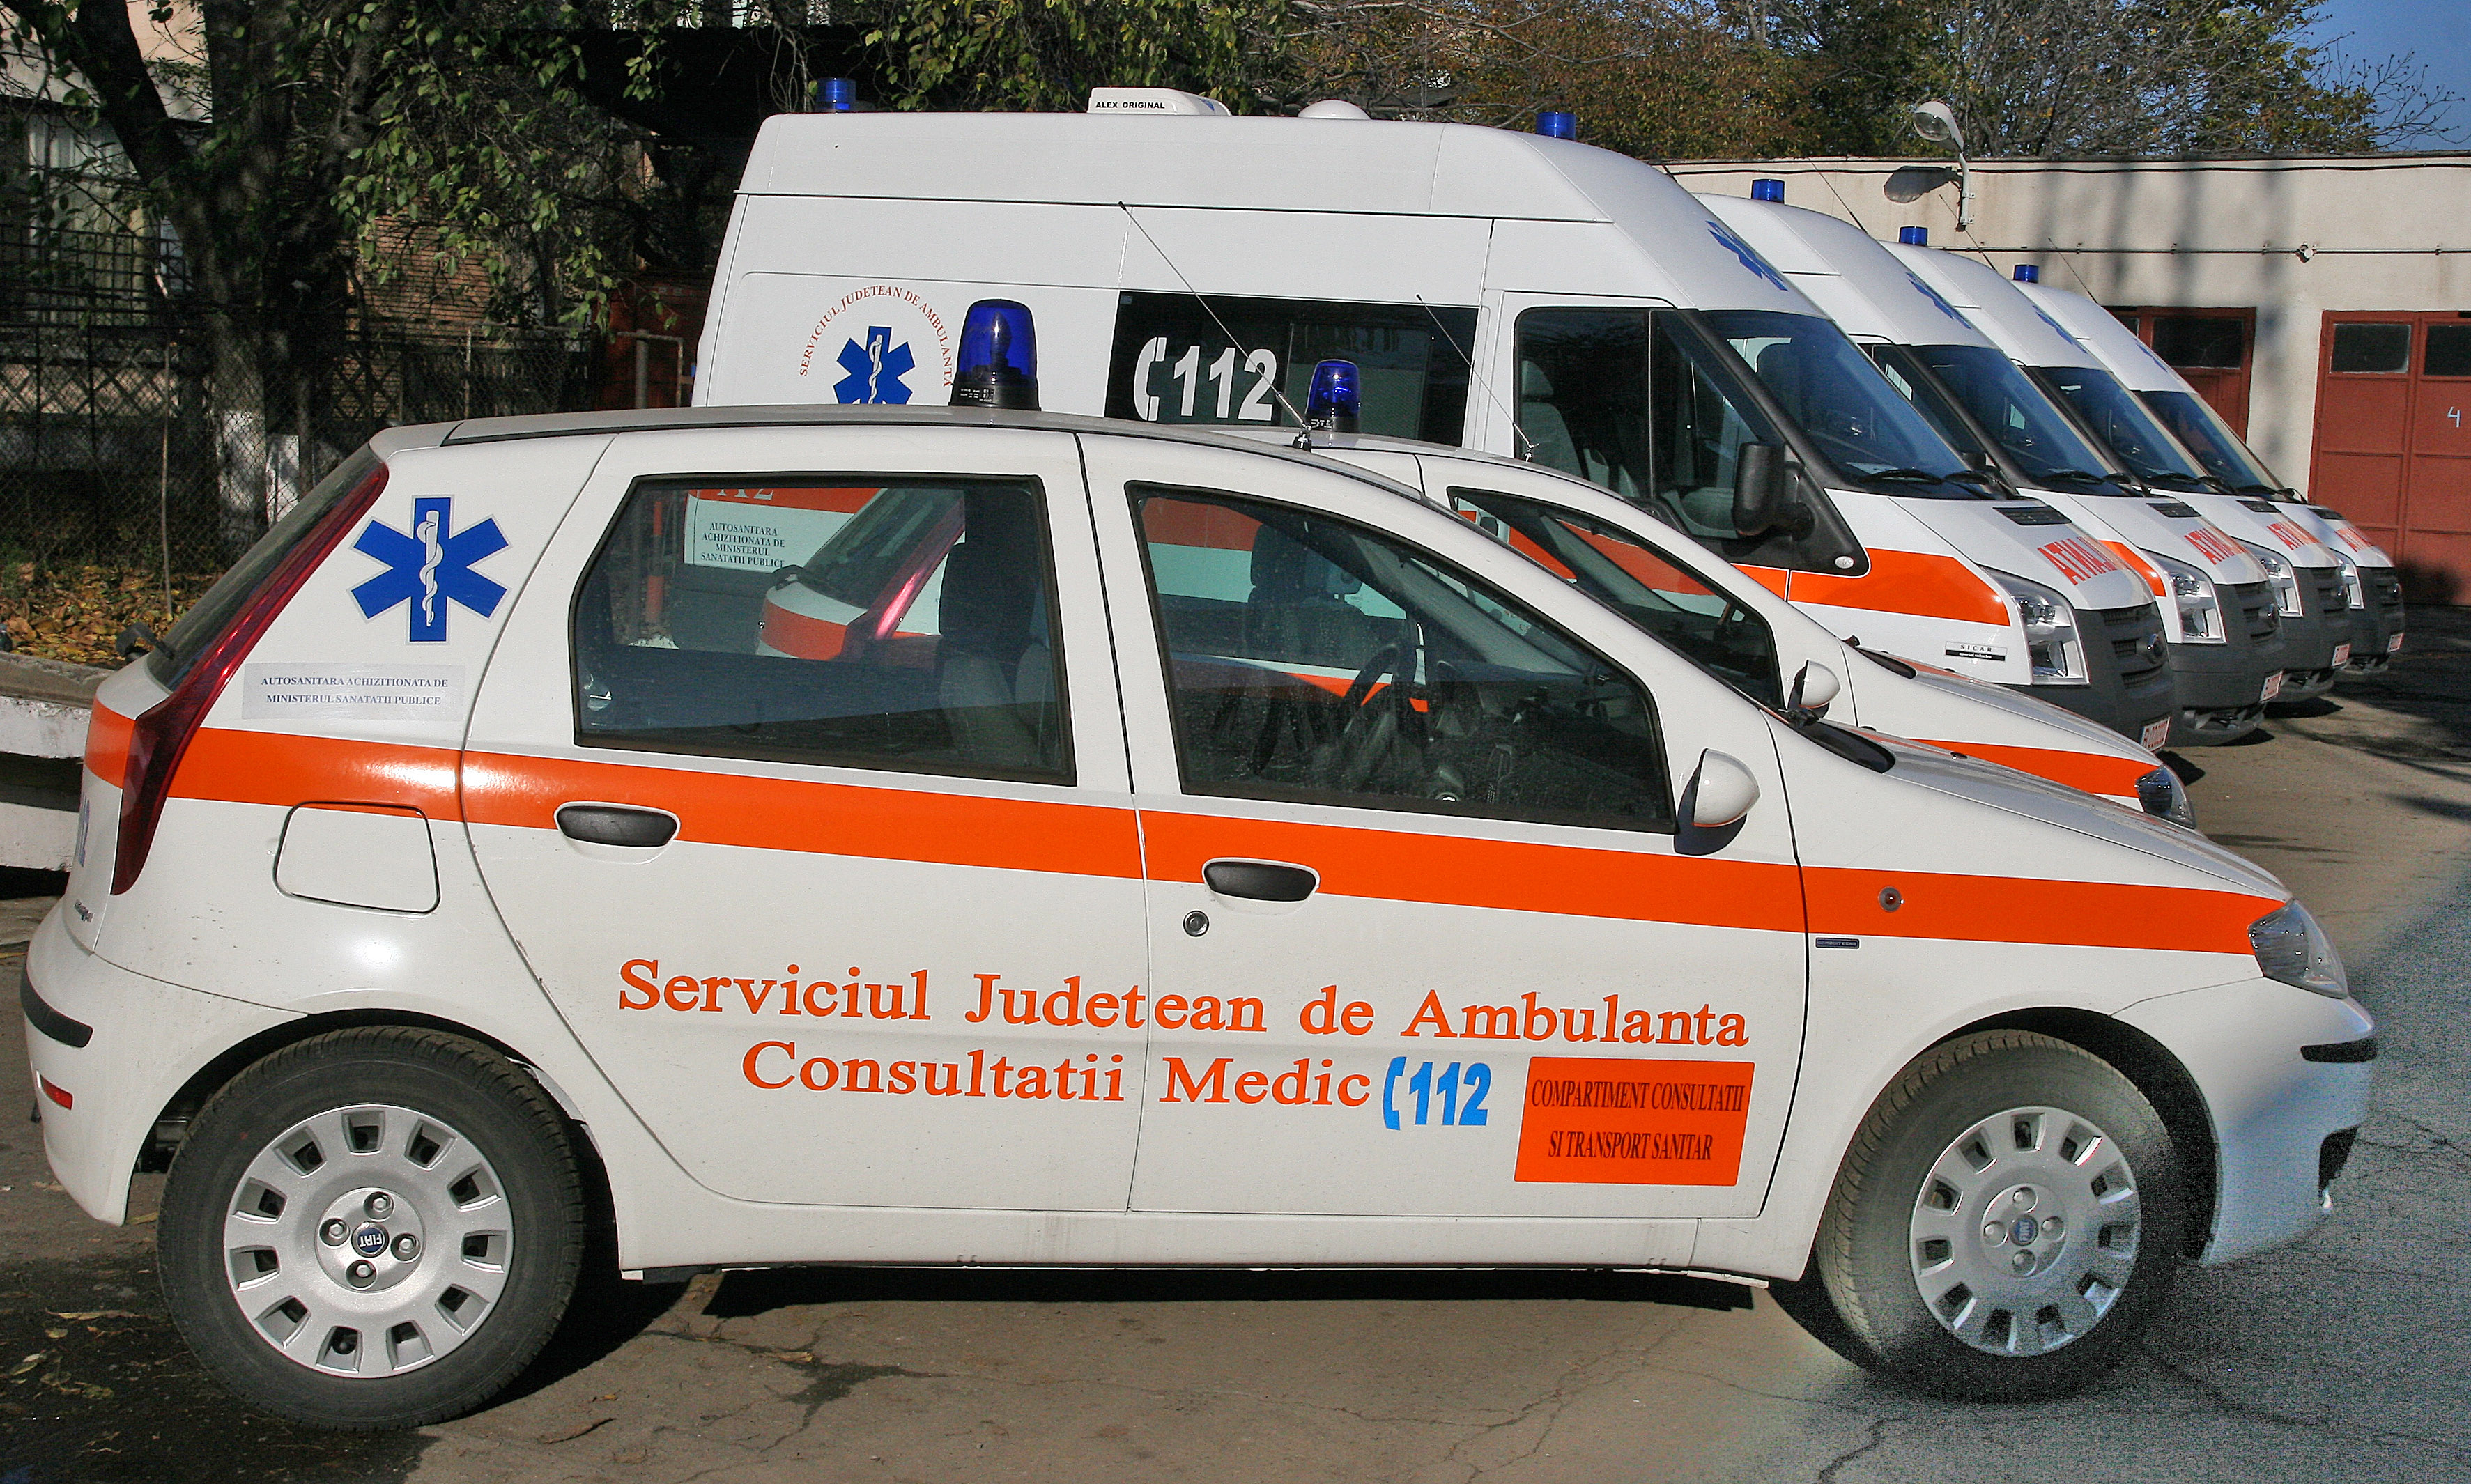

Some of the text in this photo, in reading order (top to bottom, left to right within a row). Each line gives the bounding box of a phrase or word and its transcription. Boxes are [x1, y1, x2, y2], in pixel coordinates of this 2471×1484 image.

[1122, 101, 1165, 109] ORIGINAL
[799, 285, 953, 387] SERVICIUL JUDETEAN DE AMBULANTA
[1173, 346, 1277, 421] 112
[2447, 406, 2461, 428] 4
[709, 522, 778, 536] AUTOSANITARA
[702, 532, 785, 548] ACHIZITIONATA DE
[716, 543, 770, 556] MINISTERUL
[701, 552, 745, 564] SANATATII
[261, 677, 344, 686] AUTOSANITARA
[348, 678, 431, 687] ACHIZITIONATA
[266, 695, 441, 705] MINISTERUL SANATATII PUBLICE
[619, 959, 1750, 1047] Serviciul Judetean de Ambulanta
[743, 1041, 1491, 1126] Consultatii Medic 112
[1532, 1079, 1746, 1111] COMPARTIMENT CONSULTATII
[1548, 1130, 1713, 1160] SI TRANSPORT SANITAR
[360, 1234, 382, 1247] FIAT
